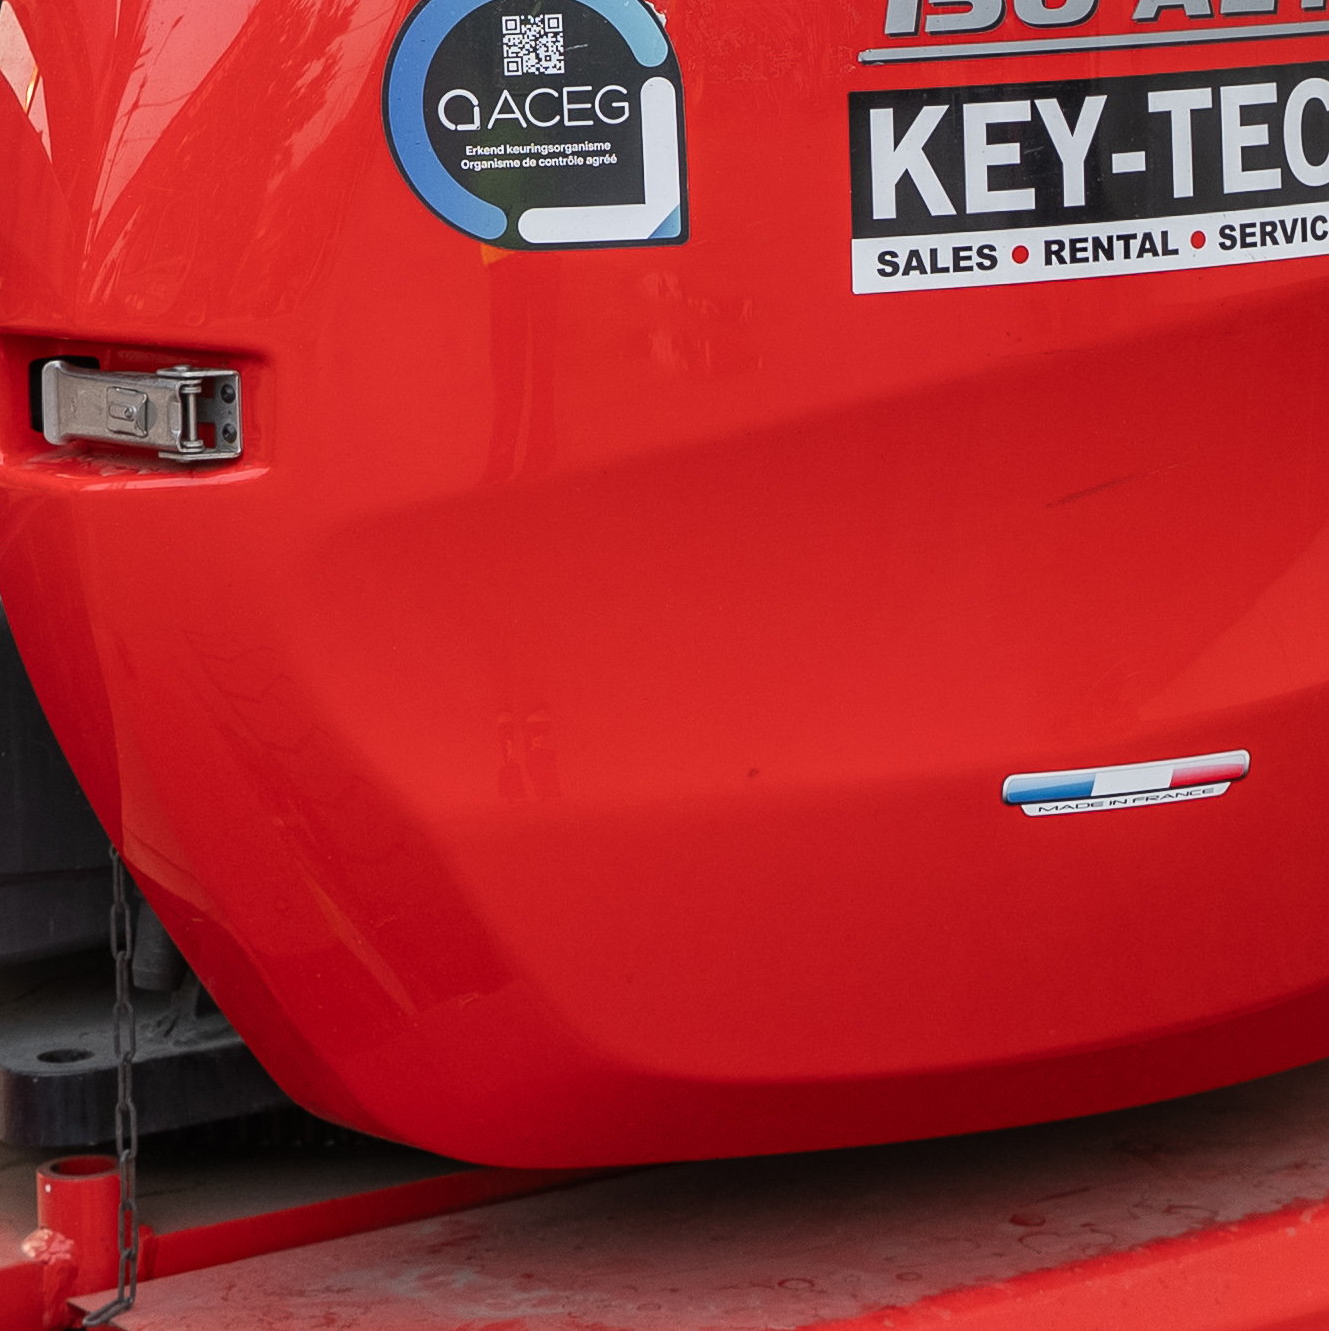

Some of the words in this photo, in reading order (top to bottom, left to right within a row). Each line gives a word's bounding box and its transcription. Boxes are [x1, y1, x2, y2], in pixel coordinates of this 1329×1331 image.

[466, 144, 505, 156] Erkend
[506, 140, 612, 156] keuringsorganisme
[460, 157, 519, 172] Organisme
[522, 156, 537, 168] de
[538, 154, 584, 167] contrôle
[585, 153, 618, 167] agréé
[877, 244, 998, 278] SALES
[1043, 230, 1180, 267] RENTAL
[1038, 800, 1104, 813] MADE
[1109, 798, 1128, 806] IN
[1133, 787, 1215, 805] FRANCE
